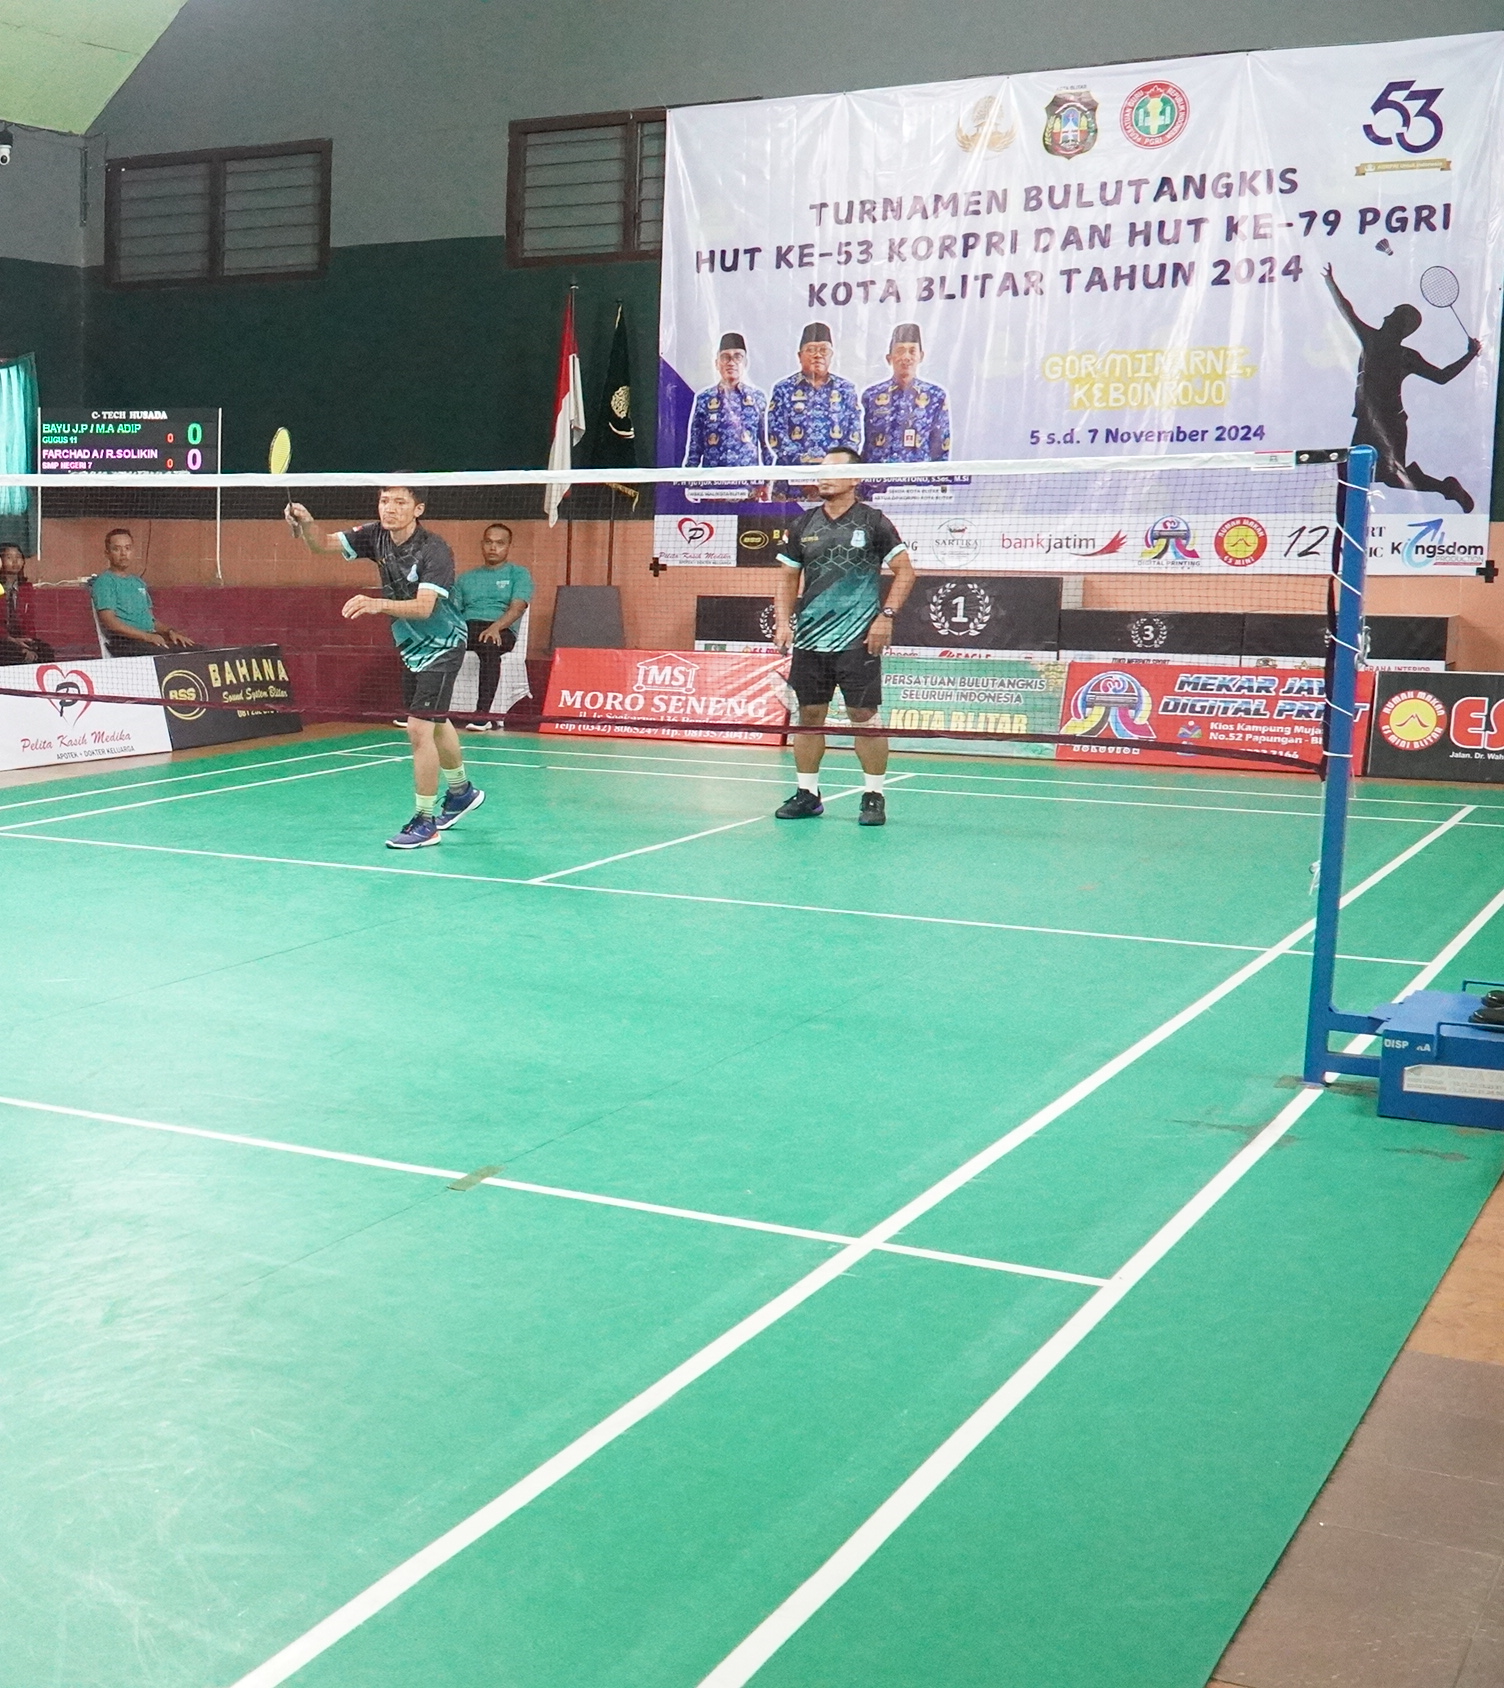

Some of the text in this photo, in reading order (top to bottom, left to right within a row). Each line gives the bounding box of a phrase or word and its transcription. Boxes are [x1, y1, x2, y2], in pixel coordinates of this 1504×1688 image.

[1363, 80, 1444, 153] 53
[1144, 137, 1163, 145] PGRI
[809, 167, 1298, 226] TURNAMEN BULUTANGKIS
[696, 203, 1452, 274] HUT KE-53 KORPRI DAN HUT KE-79 PGRI
[808, 255, 1304, 308] KOTA BLITAR TAHUN 2024
[1045, 354, 1094, 379] GOR
[129, 411, 168, 420] HUSADA
[42, 423, 71, 433] BAYU
[72, 423, 88, 433] J.P
[96, 423, 115, 433] M.A
[117, 423, 141, 433] ADIP
[167, 433, 174, 443] 0
[186, 423, 203, 445] 0
[1030, 424, 1266, 445] 5 s.d. 7 November 2024
[42, 436, 68, 444] GUGUS
[42, 449, 90, 459] FARCHAD
[106, 449, 158, 459] R.SOLIKIN
[167, 458, 174, 468] 0
[186, 448, 203, 470] 0
[1218, 519, 1265, 538] RUMAH MAKAN
[1284, 525, 1329, 557] 12
[1234, 556, 1255, 565] MINI
[950, 596, 969, 623] 1
[1143, 625, 1155, 641] 3
[208, 658, 290, 688] BAHANA
[884, 674, 1046, 690] PERSATUAN BULUTANGKIS
[1175, 673, 1279, 695] MEKAR
[222, 691, 244, 703] Sound
[246, 687, 268, 702] System
[559, 689, 646, 711] MORO
[651, 694, 767, 718] SENENG
[902, 689, 1023, 704] SELURUH INDONESIA
[1382, 690, 1446, 716] RUMAH MAKAN
[1159, 696, 1270, 718] DIGITAL
[578, 723, 611, 733] (0342)
[889, 709, 1028, 734] KOTA BLITAR
[1210, 722, 1324, 736] Kios Kampung Muja
[21, 729, 132, 753] Pelita Kasih Medika
[1209, 732, 1243, 742] No.52
[1245, 733, 1303, 745] Papungan
[1381, 724, 1444, 749] ES MINI BLITAR
[57, 746, 136, 760] APOTEK DOKTER KELUARGA
[1449, 751, 1473, 759] Jalan.
[1474, 751, 1486, 760] Dr.
